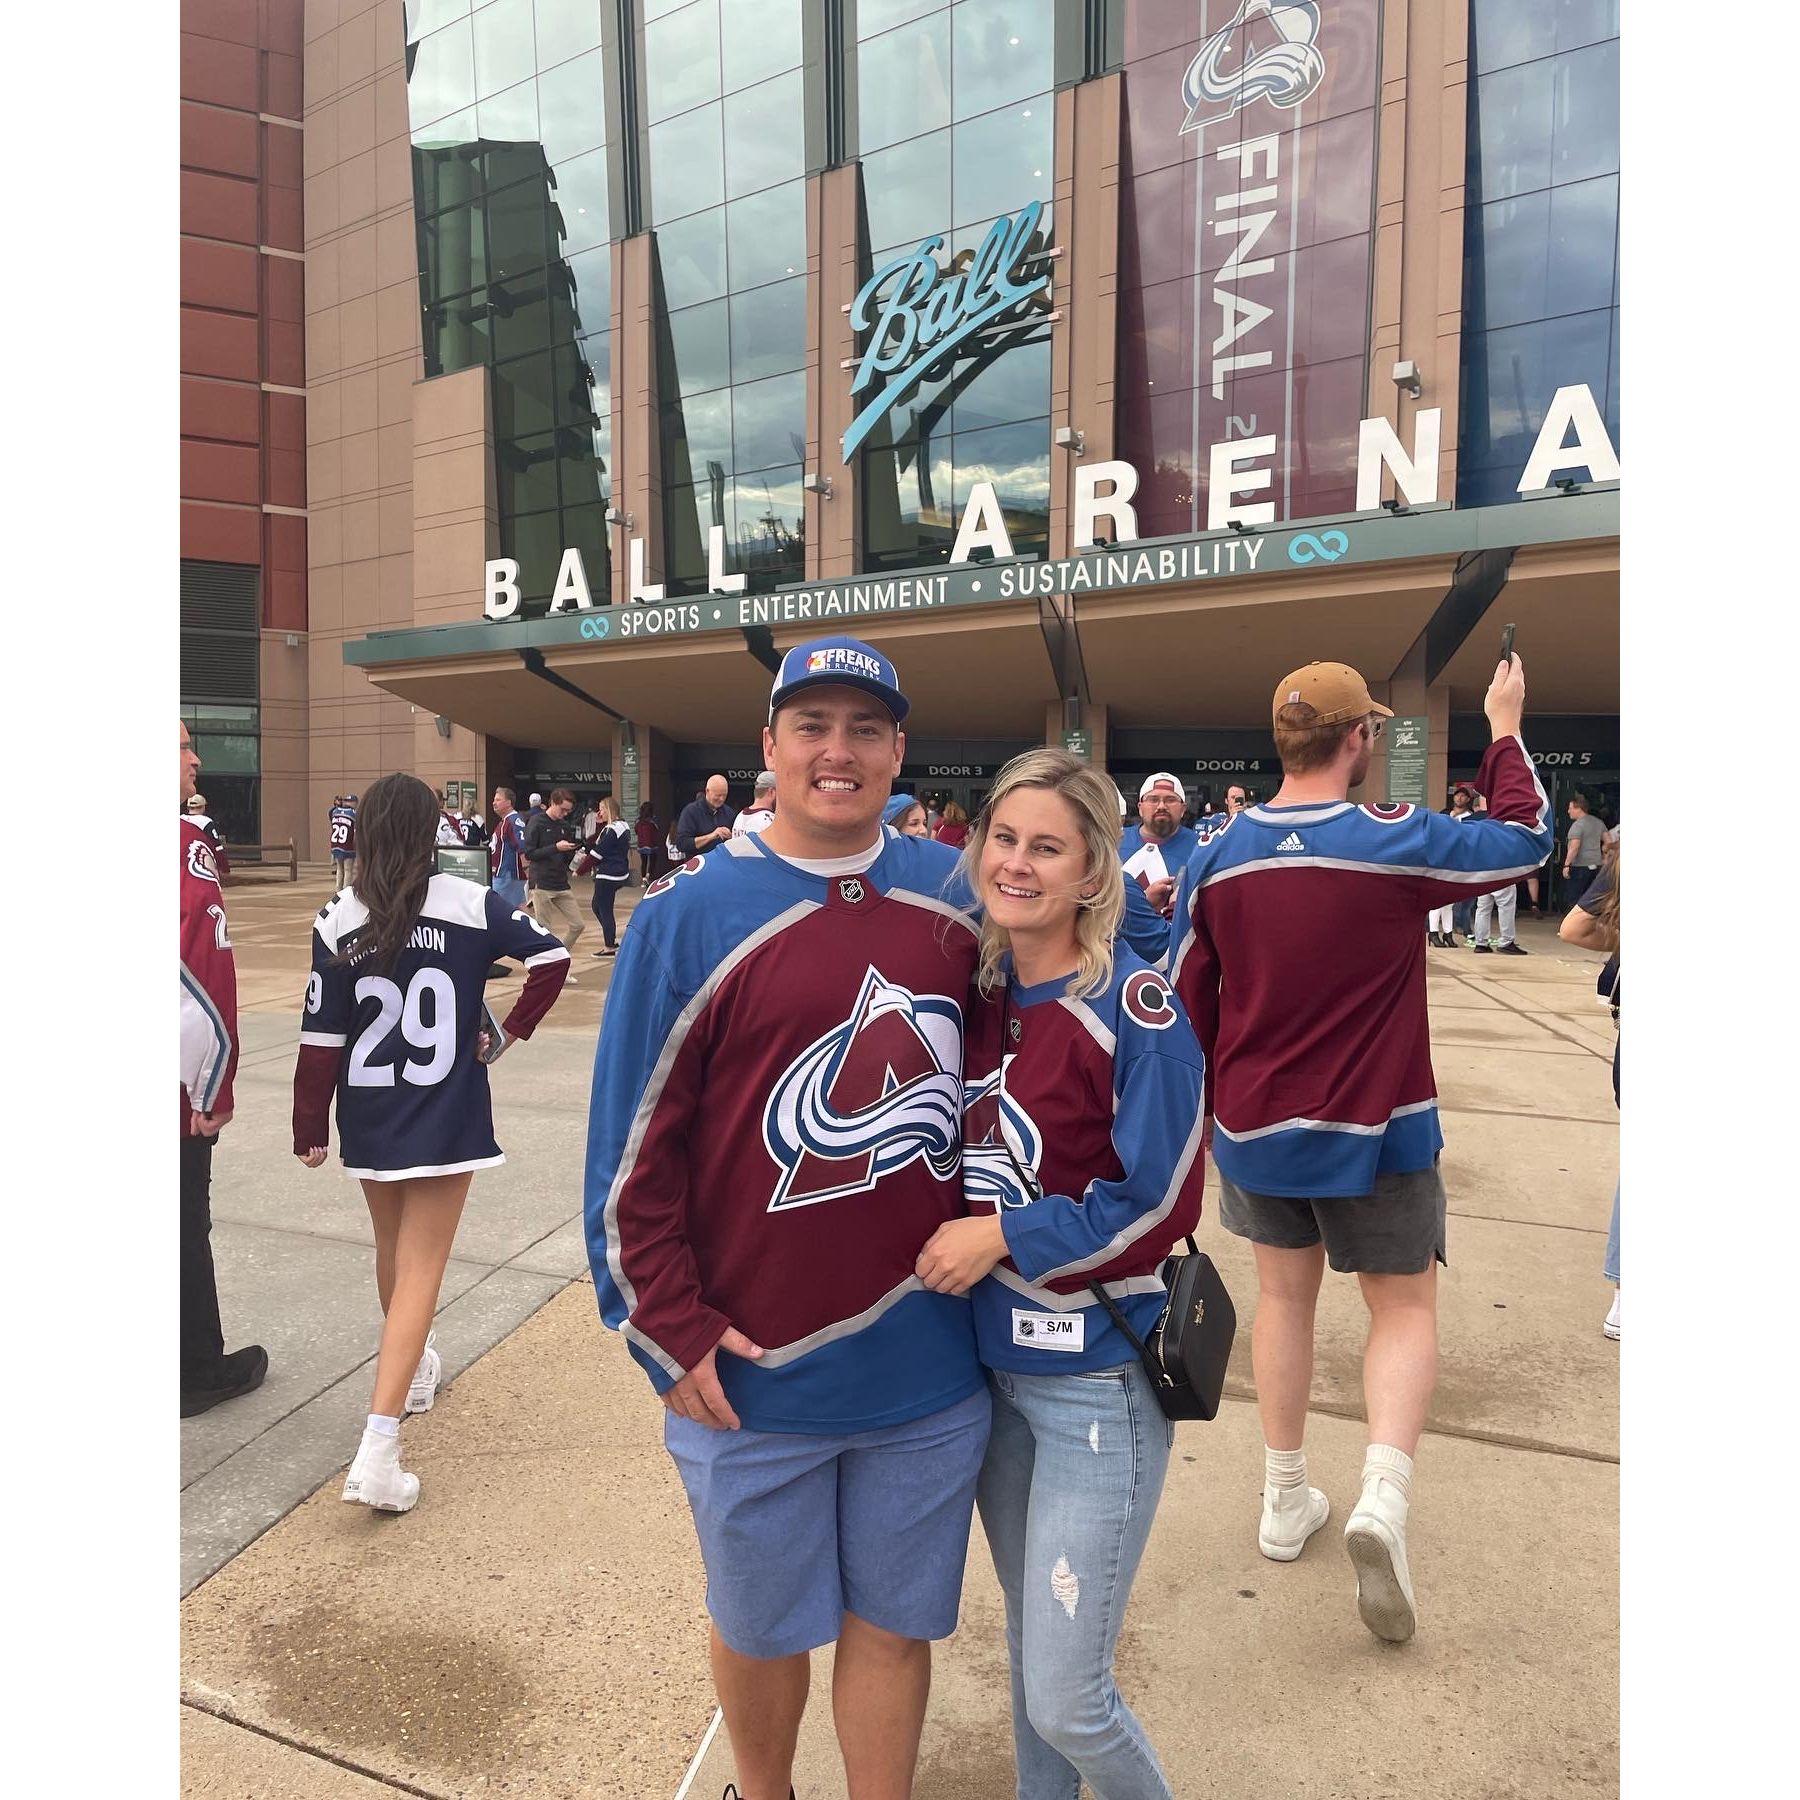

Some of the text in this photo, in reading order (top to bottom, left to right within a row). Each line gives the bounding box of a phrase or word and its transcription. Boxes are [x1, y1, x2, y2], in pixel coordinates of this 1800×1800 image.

[1212, 132, 1280, 401] FINAL
[843, 199, 1050, 464] Ball
[485, 525, 747, 620] BALL
[951, 383, 1620, 563] ARENA
[620, 538, 1265, 636] SPORTS ENTERTAINMENT SUSTAINABILITY
[827, 648, 880, 676] FREAKS
[1196, 760, 1260, 771] DOOR 4
[1531, 752, 1592, 764] OOR 5
[574, 773, 595, 782] VIP
[929, 765, 982, 775] DOOR 3
[331, 823, 348, 844] 29
[1276, 842, 1304, 851] adidas
[347, 967, 456, 1086] 29
[1046, 1321, 1072, 1333] S/M
